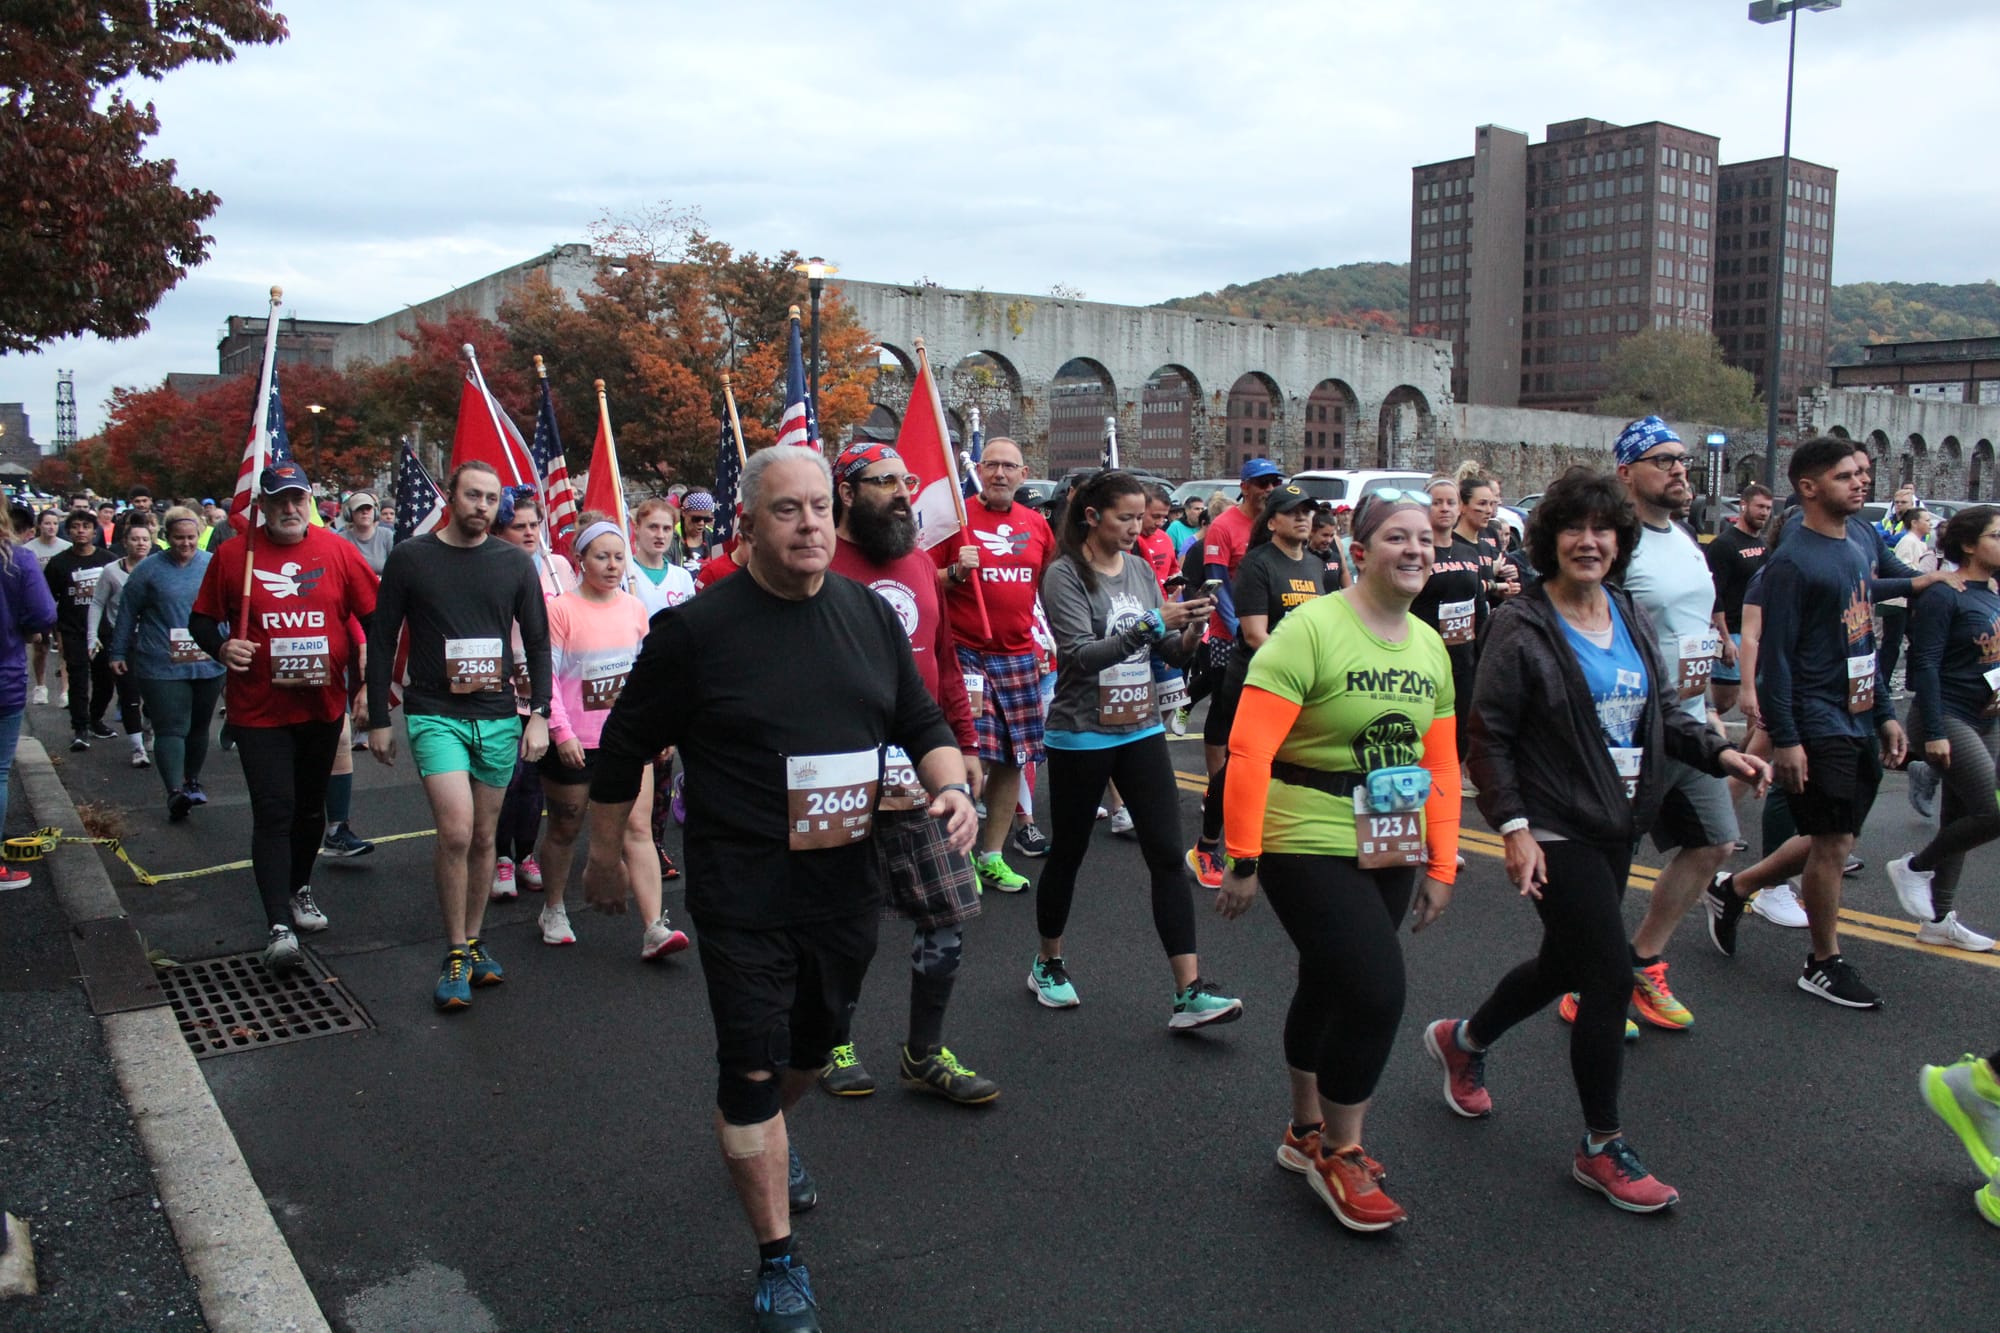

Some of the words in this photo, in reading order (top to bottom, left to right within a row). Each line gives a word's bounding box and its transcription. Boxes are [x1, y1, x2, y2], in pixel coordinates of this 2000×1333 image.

[982, 567, 1033, 583] RWB
[1289, 578, 1317, 593] VEGAN
[262, 611, 325, 630] RWB
[1446, 616, 1472, 631] 2347
[291, 640, 324, 652] FARID
[279, 658, 310, 671] 222
[313, 657, 324, 669] A
[457, 659, 496, 675] 2568
[591, 678, 616, 694] 177
[1109, 686, 1149, 703] 2088
[806, 787, 868, 816] 2666
[1369, 816, 1403, 838] 123
[1406, 816, 1418, 836] A
